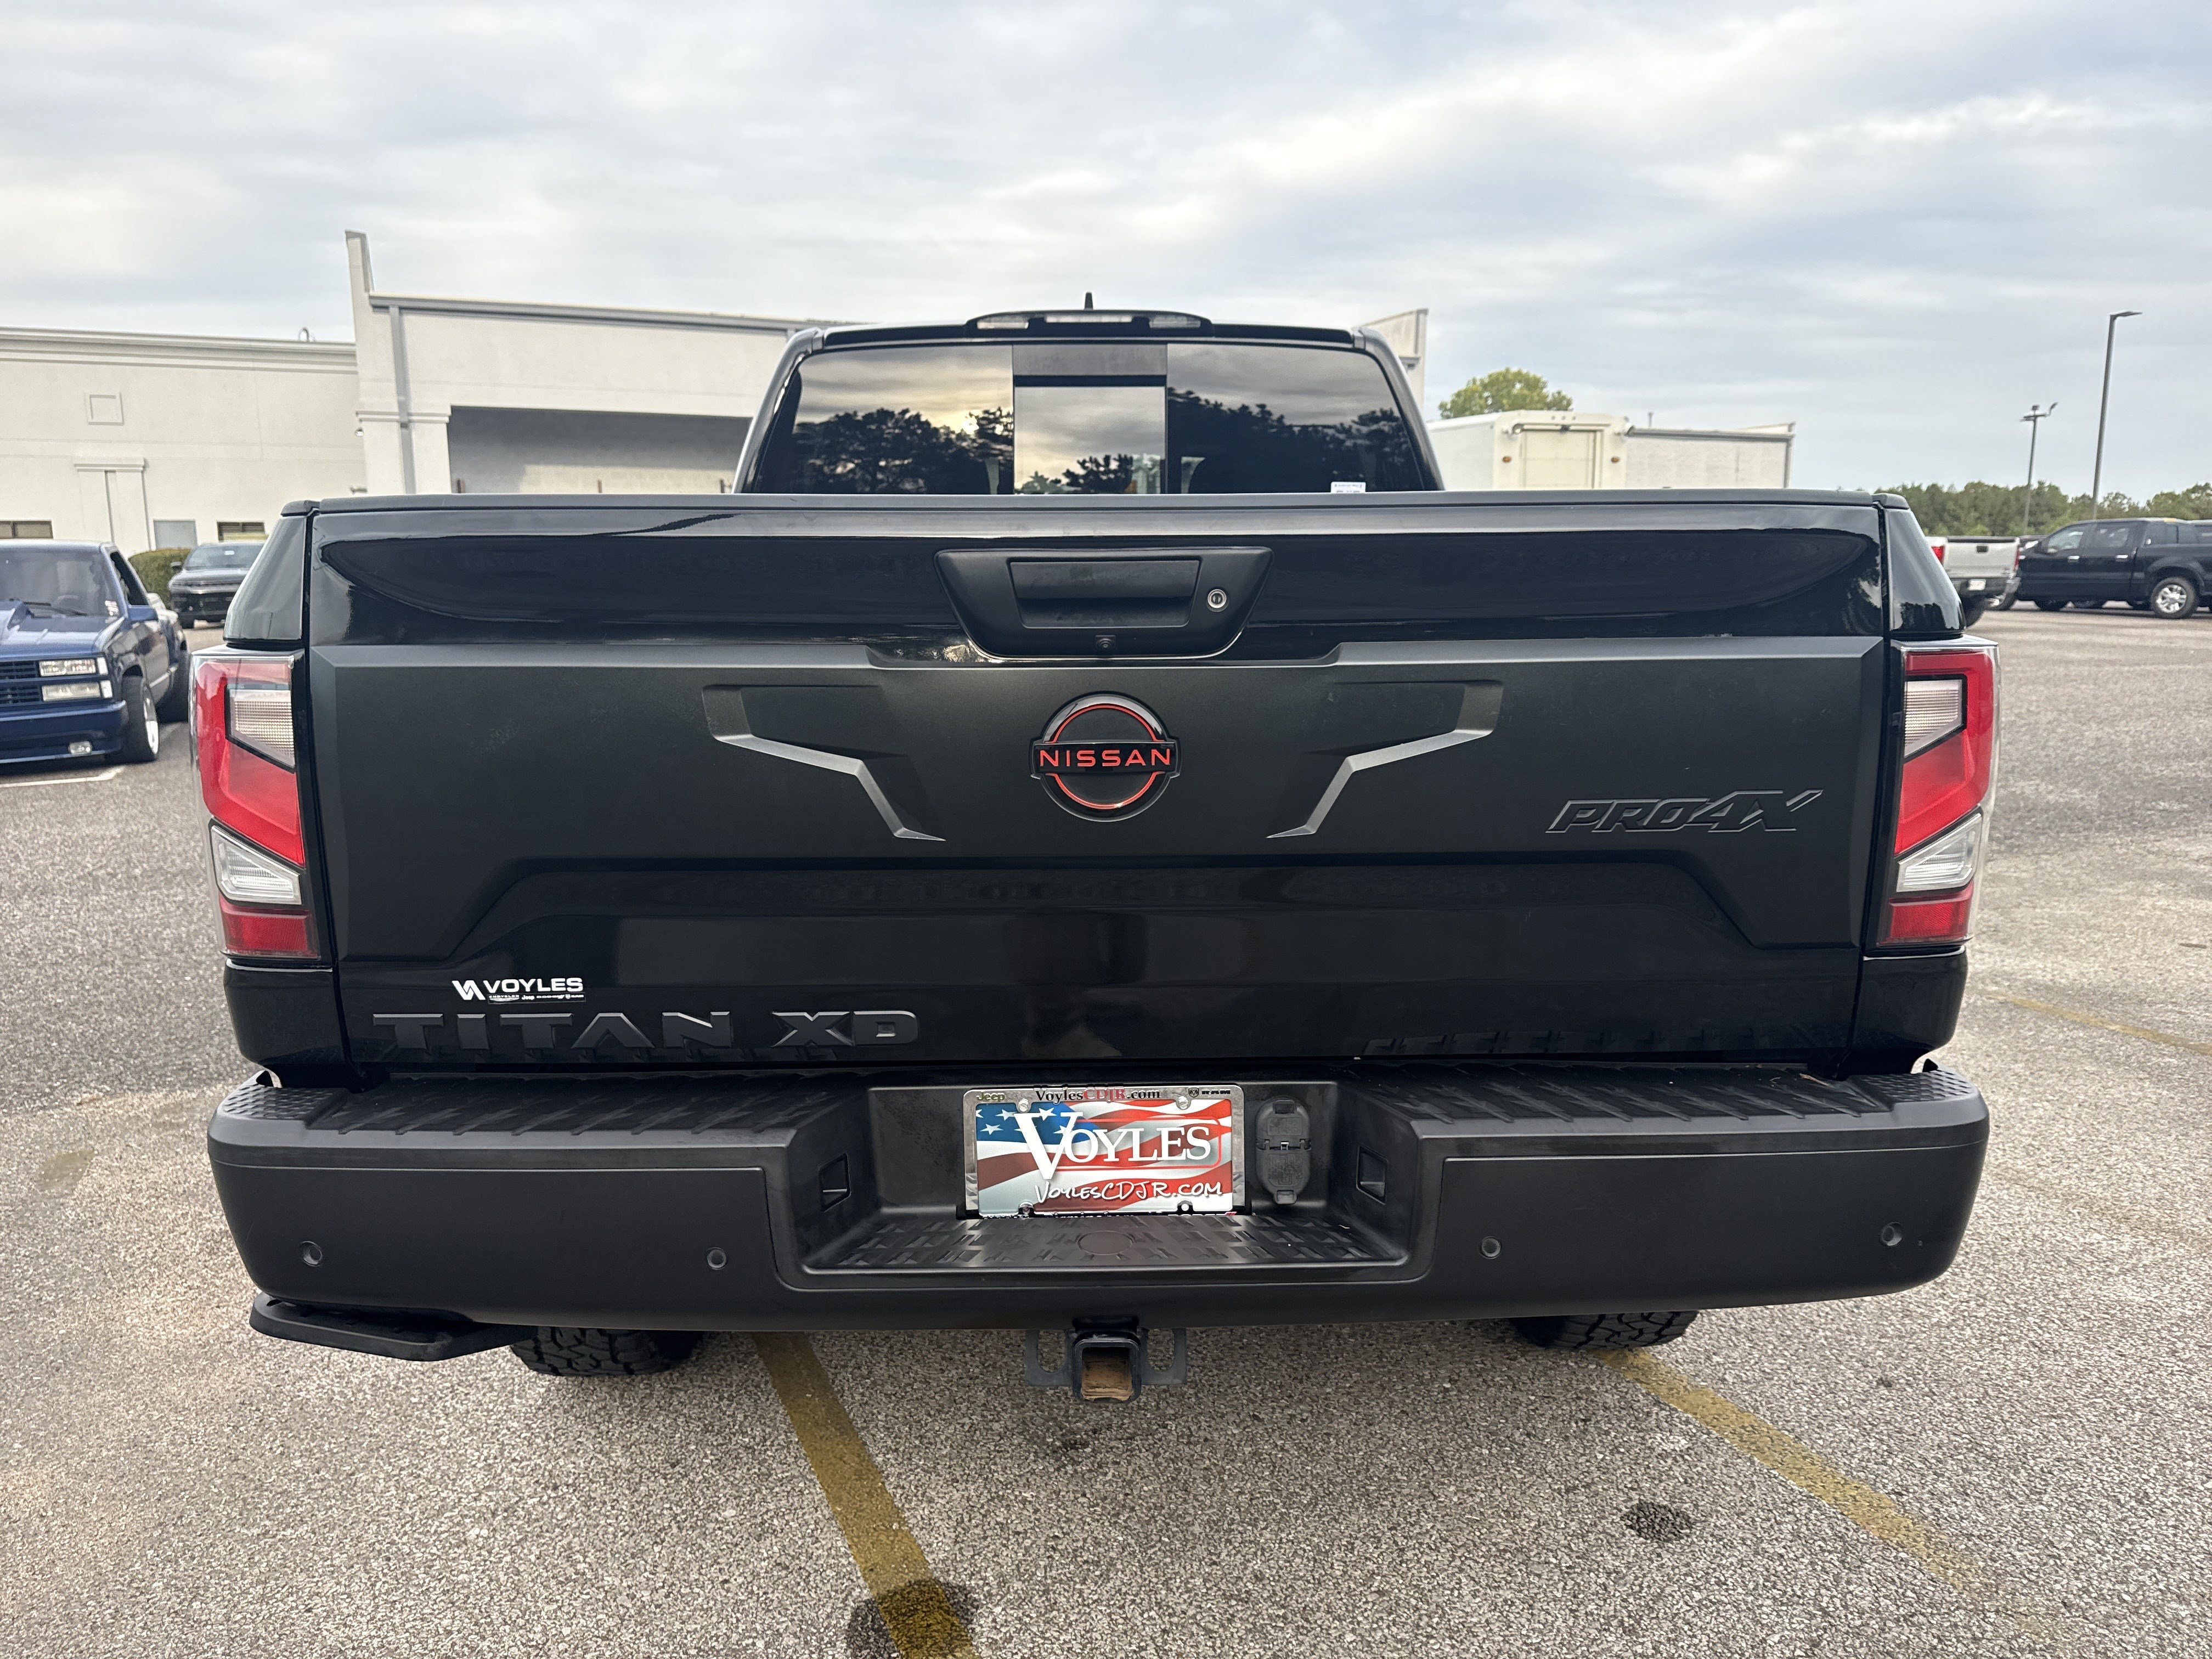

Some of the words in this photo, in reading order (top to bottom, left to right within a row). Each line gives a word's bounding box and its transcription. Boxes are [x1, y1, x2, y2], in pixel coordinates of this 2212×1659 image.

[1040, 748, 1171, 767] NISSAN
[483, 977, 583, 994] VOYLES
[373, 1012, 733, 1049] TITAN
[771, 1011, 919, 1048] XD
[976, 1090, 1005, 1102] Jeep
[1033, 1086, 1161, 1104] VoylesCDJR.com
[1013, 1111, 1211, 1181] VOYLES
